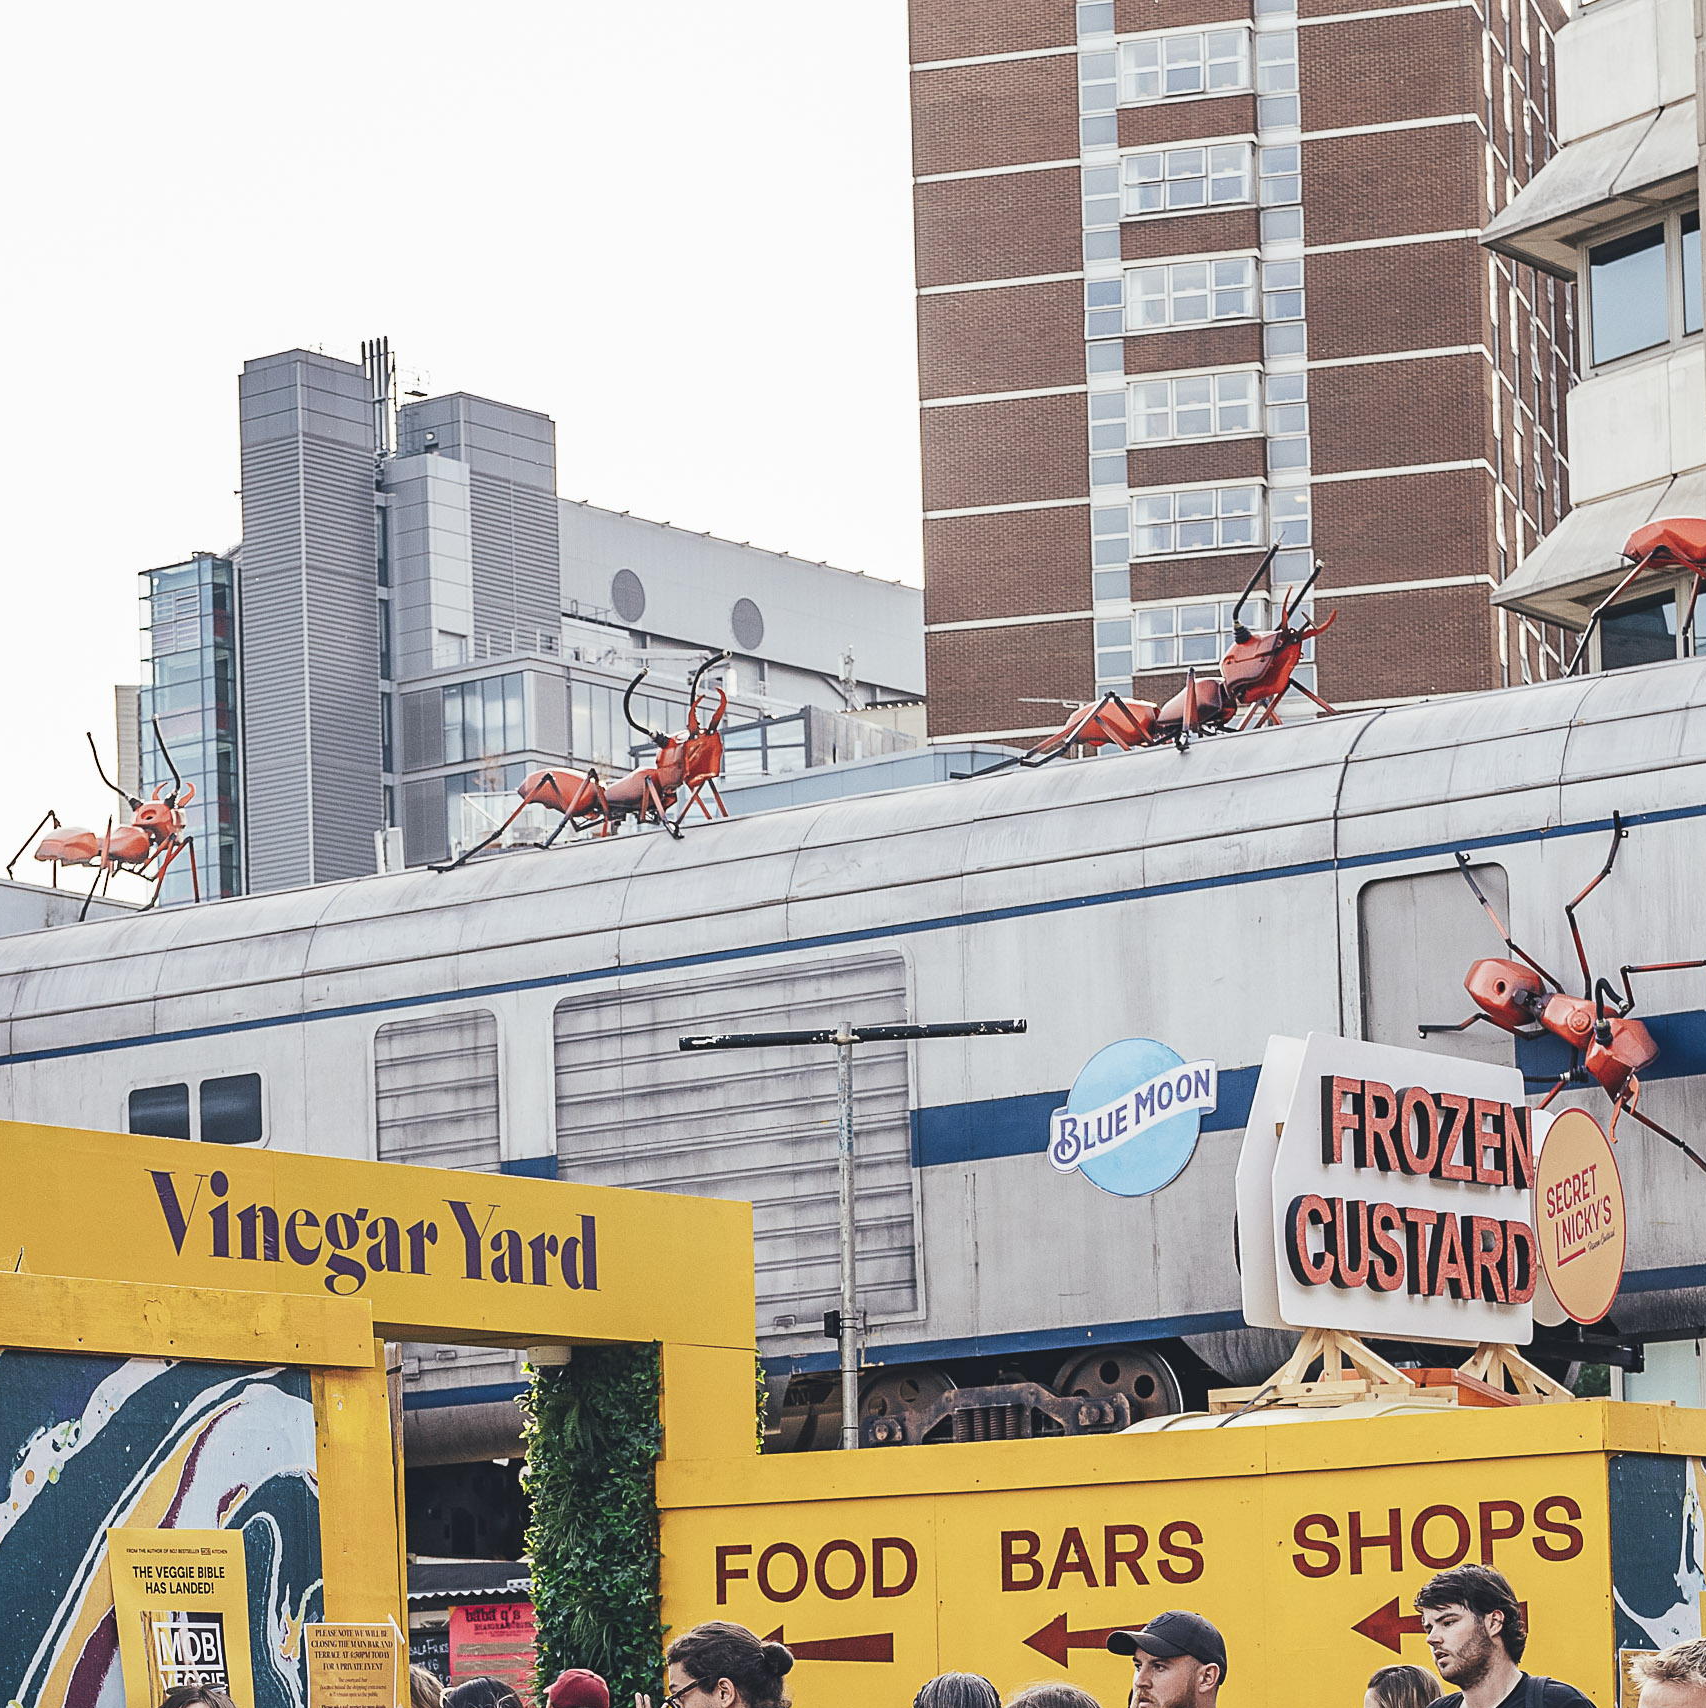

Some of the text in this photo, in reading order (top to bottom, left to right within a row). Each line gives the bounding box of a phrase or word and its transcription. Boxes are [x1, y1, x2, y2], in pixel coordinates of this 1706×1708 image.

[1053, 1069, 1210, 1165] BLUE MOON
[1321, 1075, 1534, 1190] FROZEN
[1546, 1163, 1597, 1219] SECRET
[144, 1169, 602, 1296] Vinegar Yard
[1285, 1193, 1538, 1305] CUSTARD
[1563, 1194, 1612, 1249] NICKY'S
[1001, 1521, 1205, 1592] BARS
[1293, 1495, 1584, 1578] SHOPS
[132, 1566, 225, 1579] THE VEGGIE BIBLE
[145, 1582, 215, 1595] HAS LANDED!
[715, 1537, 919, 1605] FOOD
[159, 1631, 217, 1662] MOB
[311, 1640, 337, 1648] CLOSING
[338, 1640, 349, 1648] THE
[350, 1640, 367, 1648] MAIN
[367, 1640, 380, 1648] BAR
[314, 1651, 340, 1659] TERRACE
[371, 1651, 390, 1659] TODAY
[315, 1629, 336, 1637] PLEASE
[338, 1629, 353, 1637] NOTE
[354, 1629, 364, 1637] WE
[340, 1663, 363, 1671] PRIVATE
[364, 1663, 383, 1671] EVENT
